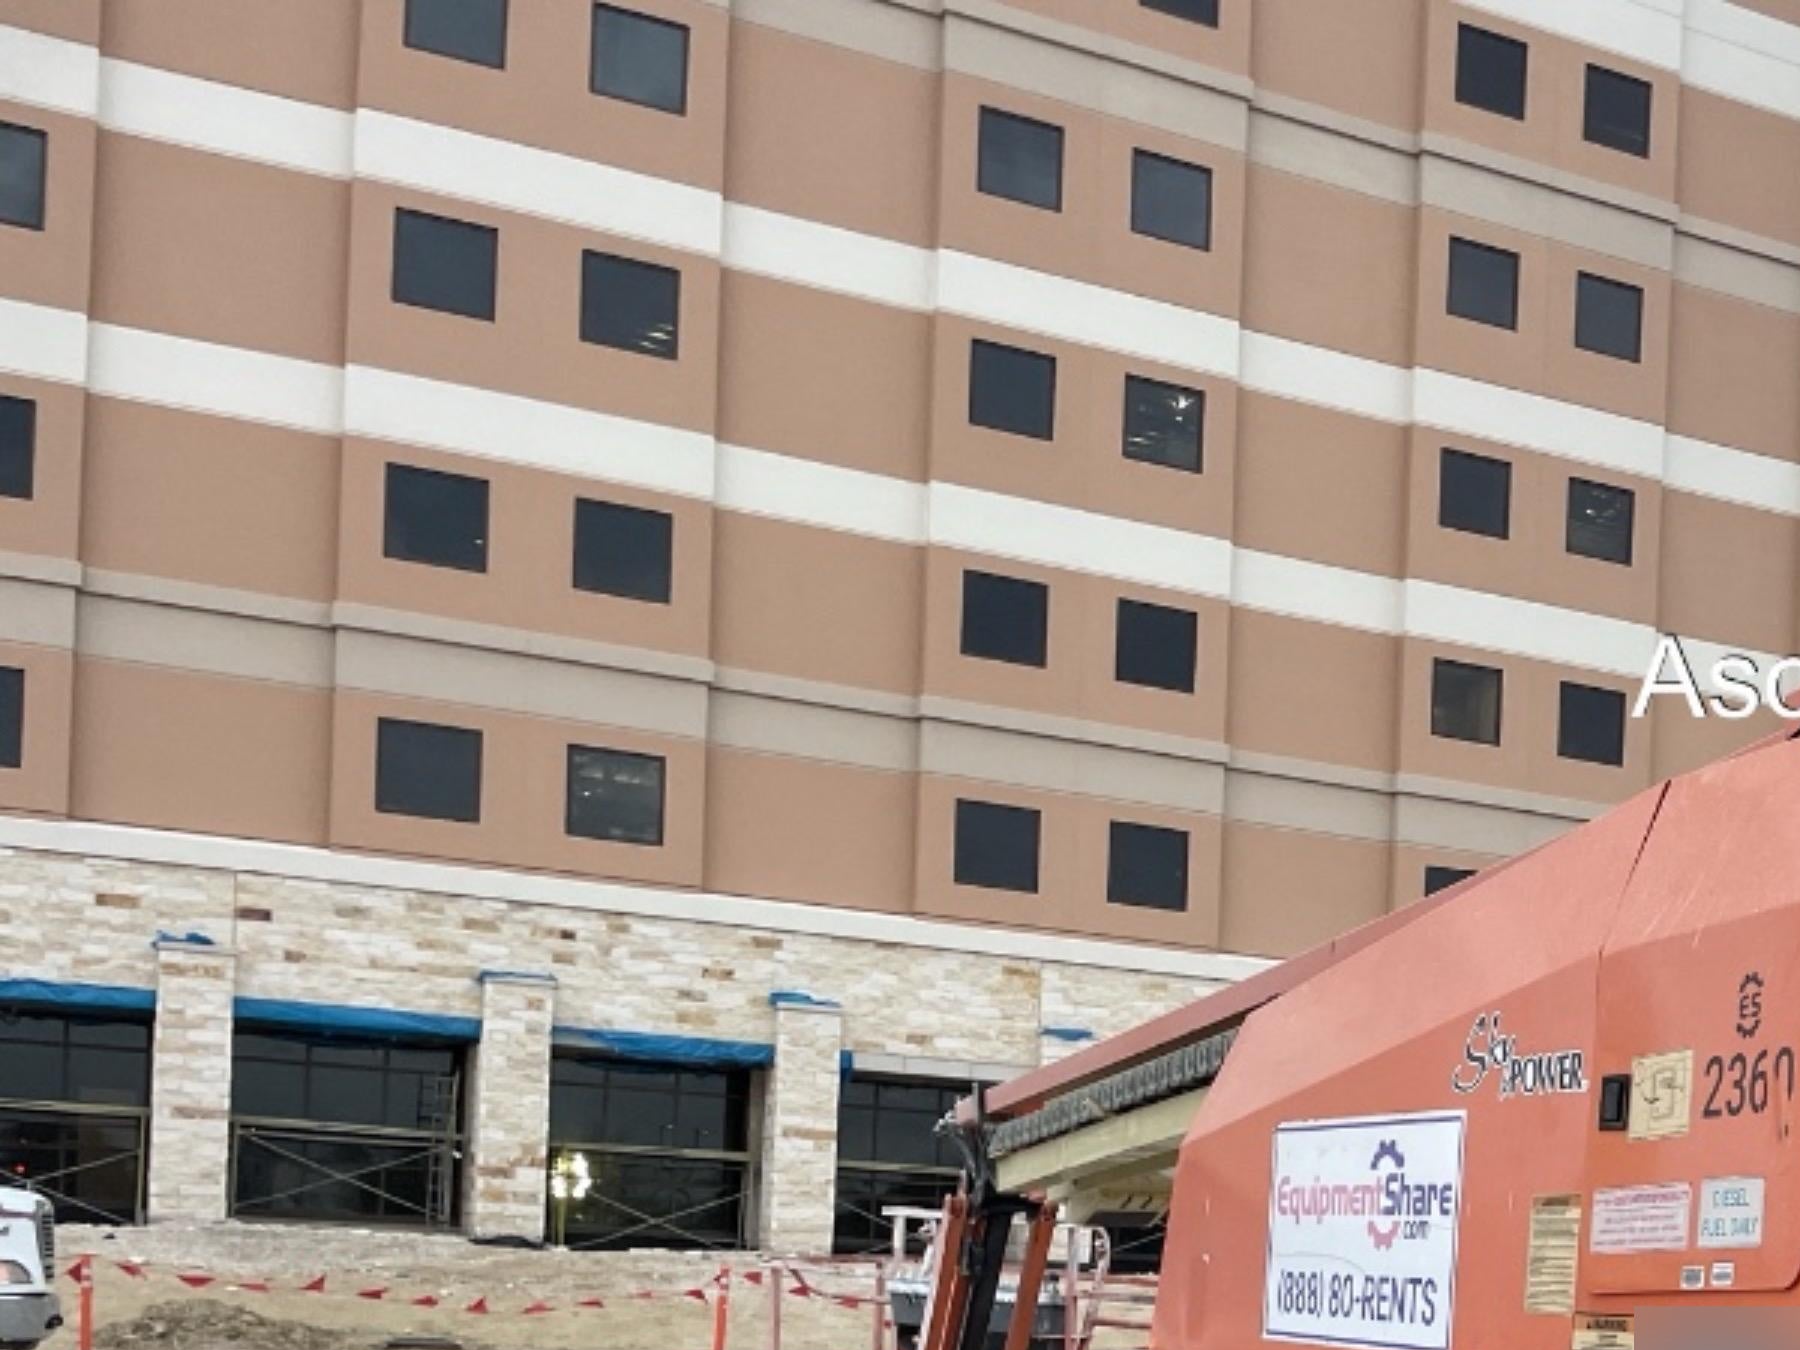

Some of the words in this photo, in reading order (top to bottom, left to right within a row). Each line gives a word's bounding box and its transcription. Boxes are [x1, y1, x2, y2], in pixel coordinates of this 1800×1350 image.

[1277, 1173, 1454, 1225] EquipmentShare
[1278, 1268, 1324, 1319] (888)
[1328, 1273, 1438, 1327] 80-RENTS
